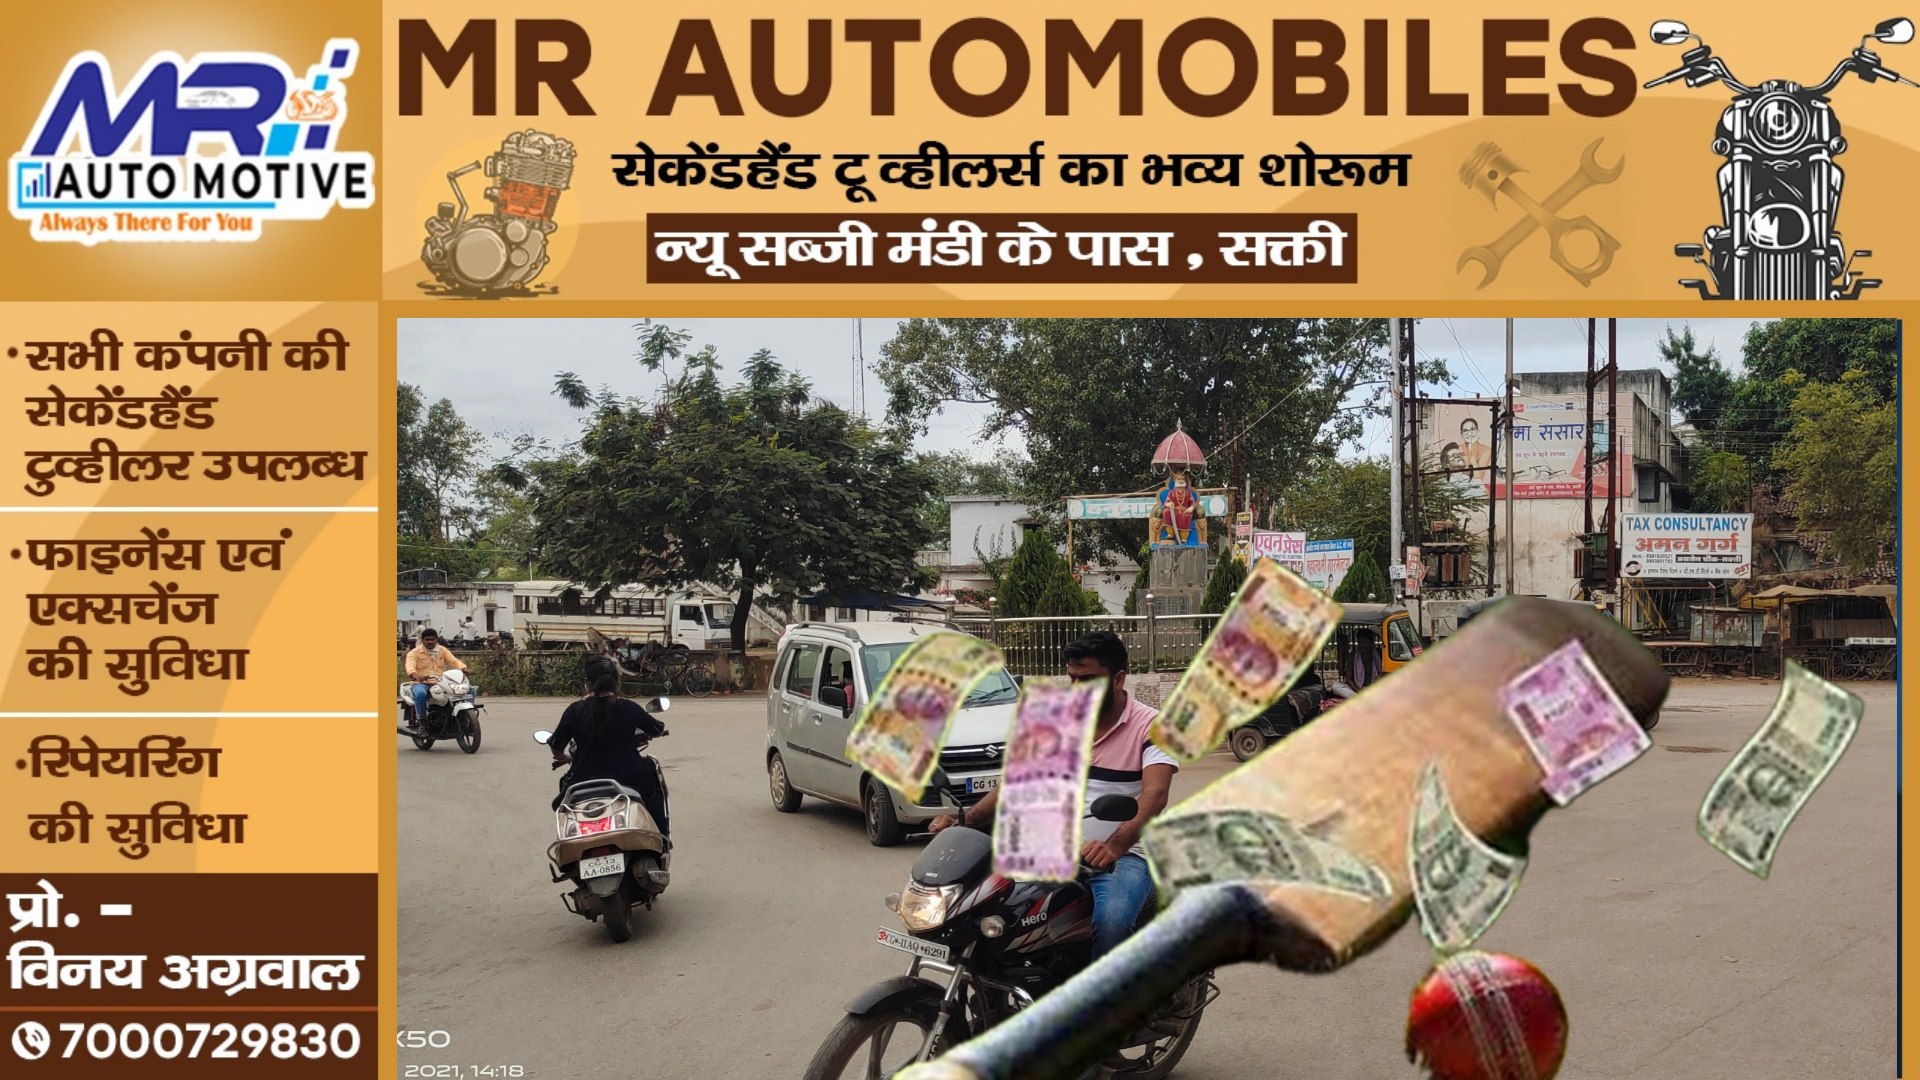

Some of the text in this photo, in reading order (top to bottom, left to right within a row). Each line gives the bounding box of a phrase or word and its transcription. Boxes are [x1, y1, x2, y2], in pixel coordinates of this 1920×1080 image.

[1539, 418, 1584, 441] संसार
[1626, 517, 1748, 531] TAX CONSULTANCY
[1635, 532, 1739, 553] अमन गर्ग
[973, 779, 997, 789] CG 13
[1021, 911, 1048, 927] Hero
